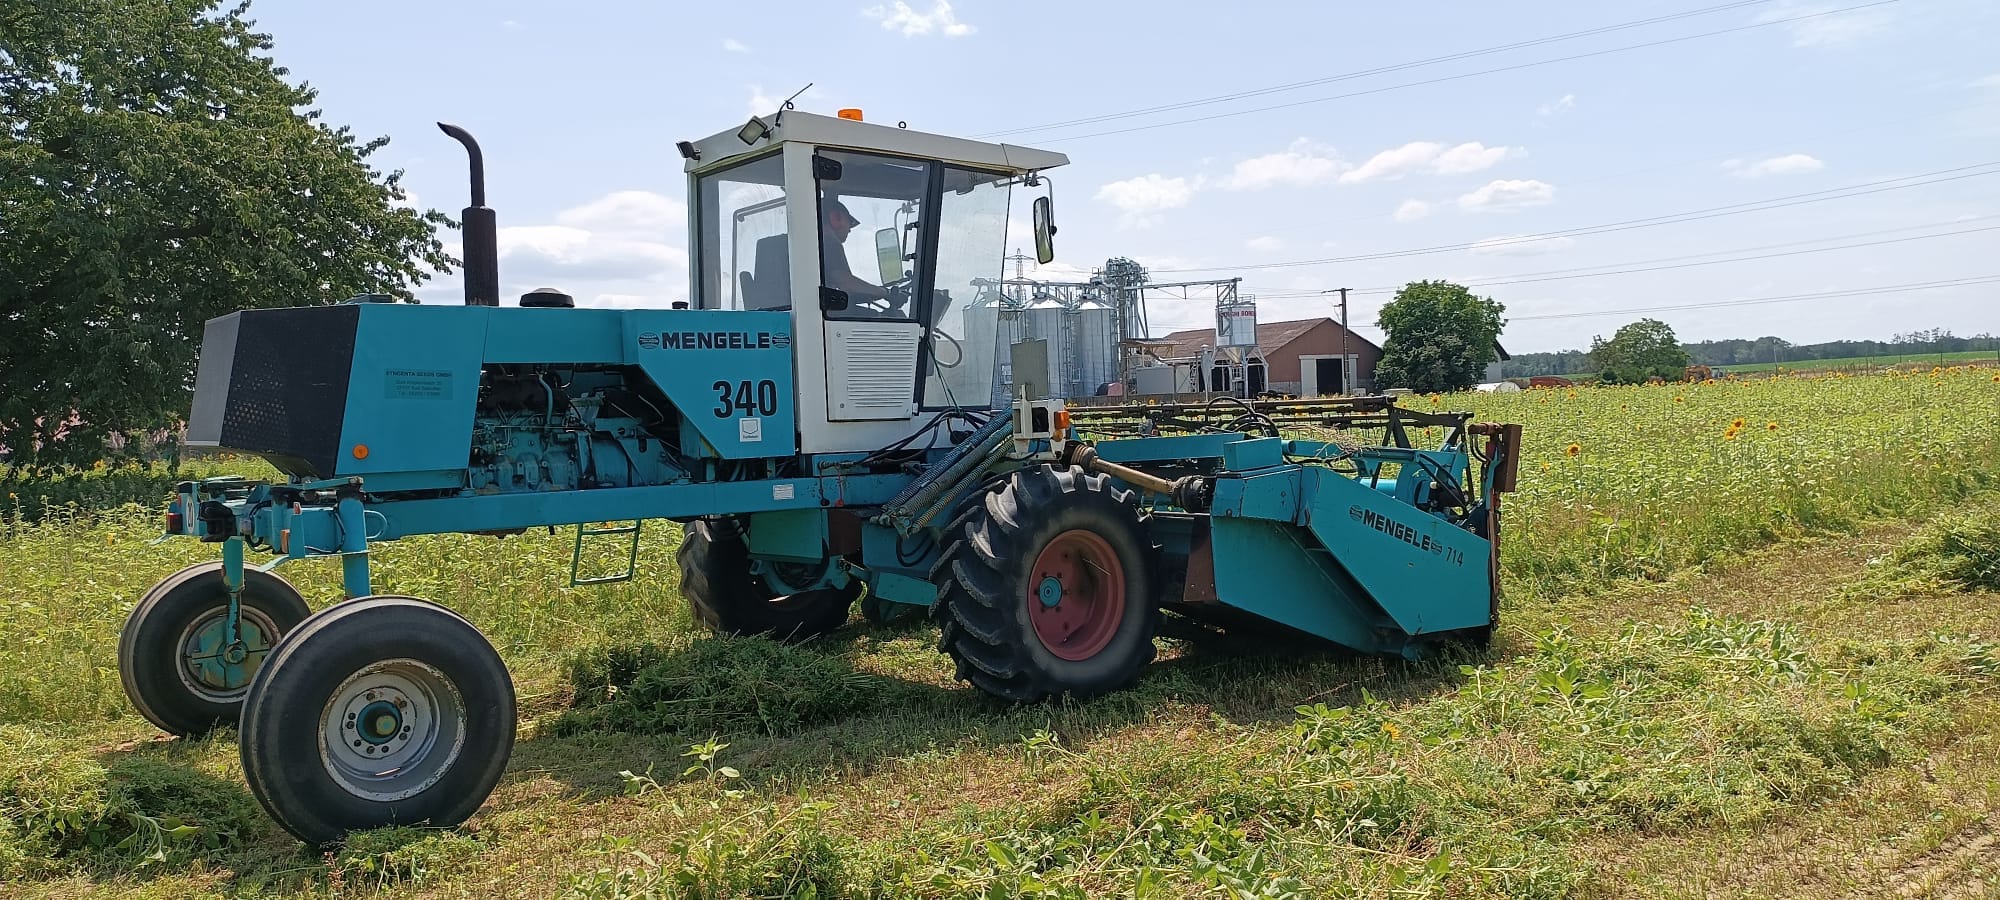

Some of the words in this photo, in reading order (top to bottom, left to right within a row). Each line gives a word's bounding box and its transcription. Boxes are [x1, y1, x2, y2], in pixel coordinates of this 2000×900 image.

[661, 332, 770, 350] MENGELE
[712, 379, 778, 419] 340
[1363, 509, 1431, 551] MENGELE
[1446, 547, 1464, 567] 714
